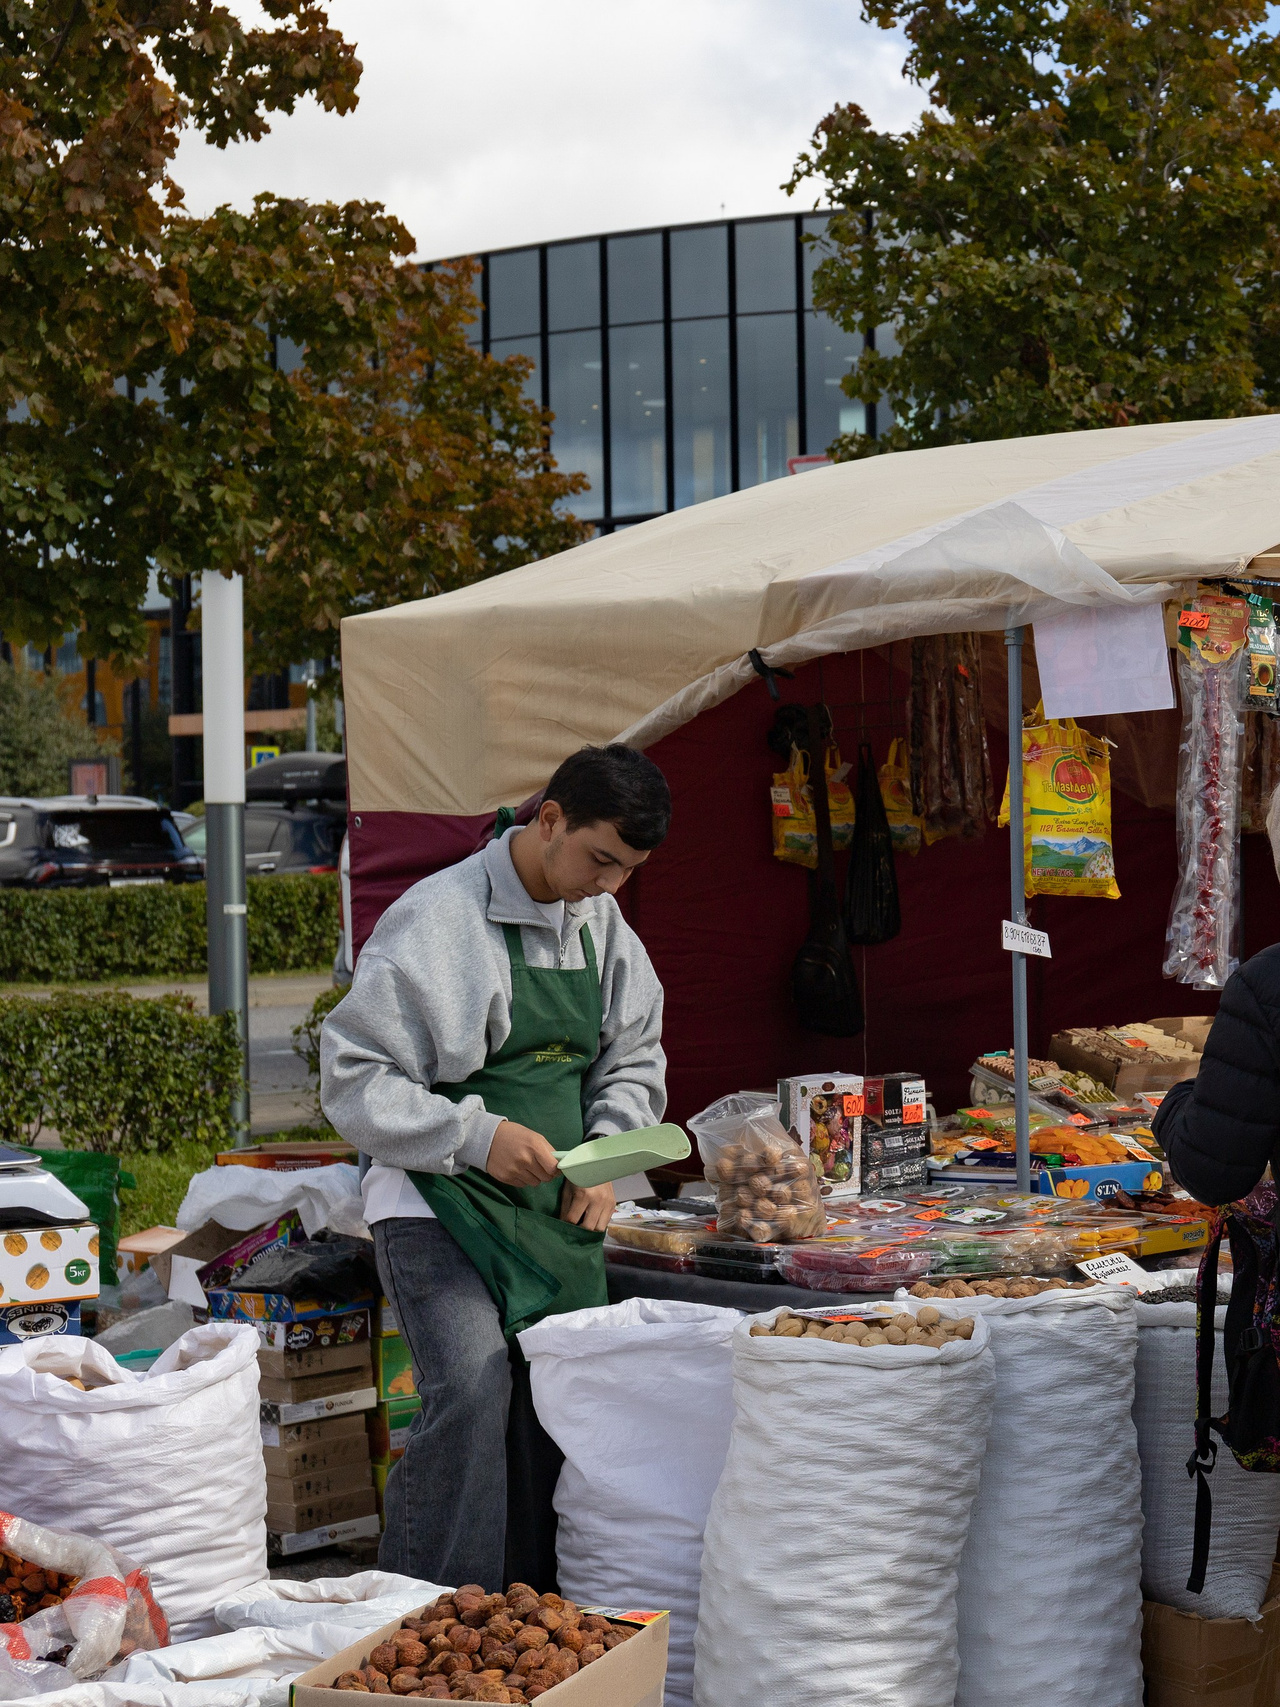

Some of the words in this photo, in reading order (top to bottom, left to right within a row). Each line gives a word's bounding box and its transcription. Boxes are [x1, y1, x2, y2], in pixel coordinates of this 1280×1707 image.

[1181, 617, 1205, 627] 200
[1056, 824, 1085, 834] Basmati
[1032, 868, 1044, 877] NET
[1182, 1228, 1205, 1241] Apricot
[69, 1266, 86, 1278] 5кг
[8, 1303, 64, 1320] PRUNES
